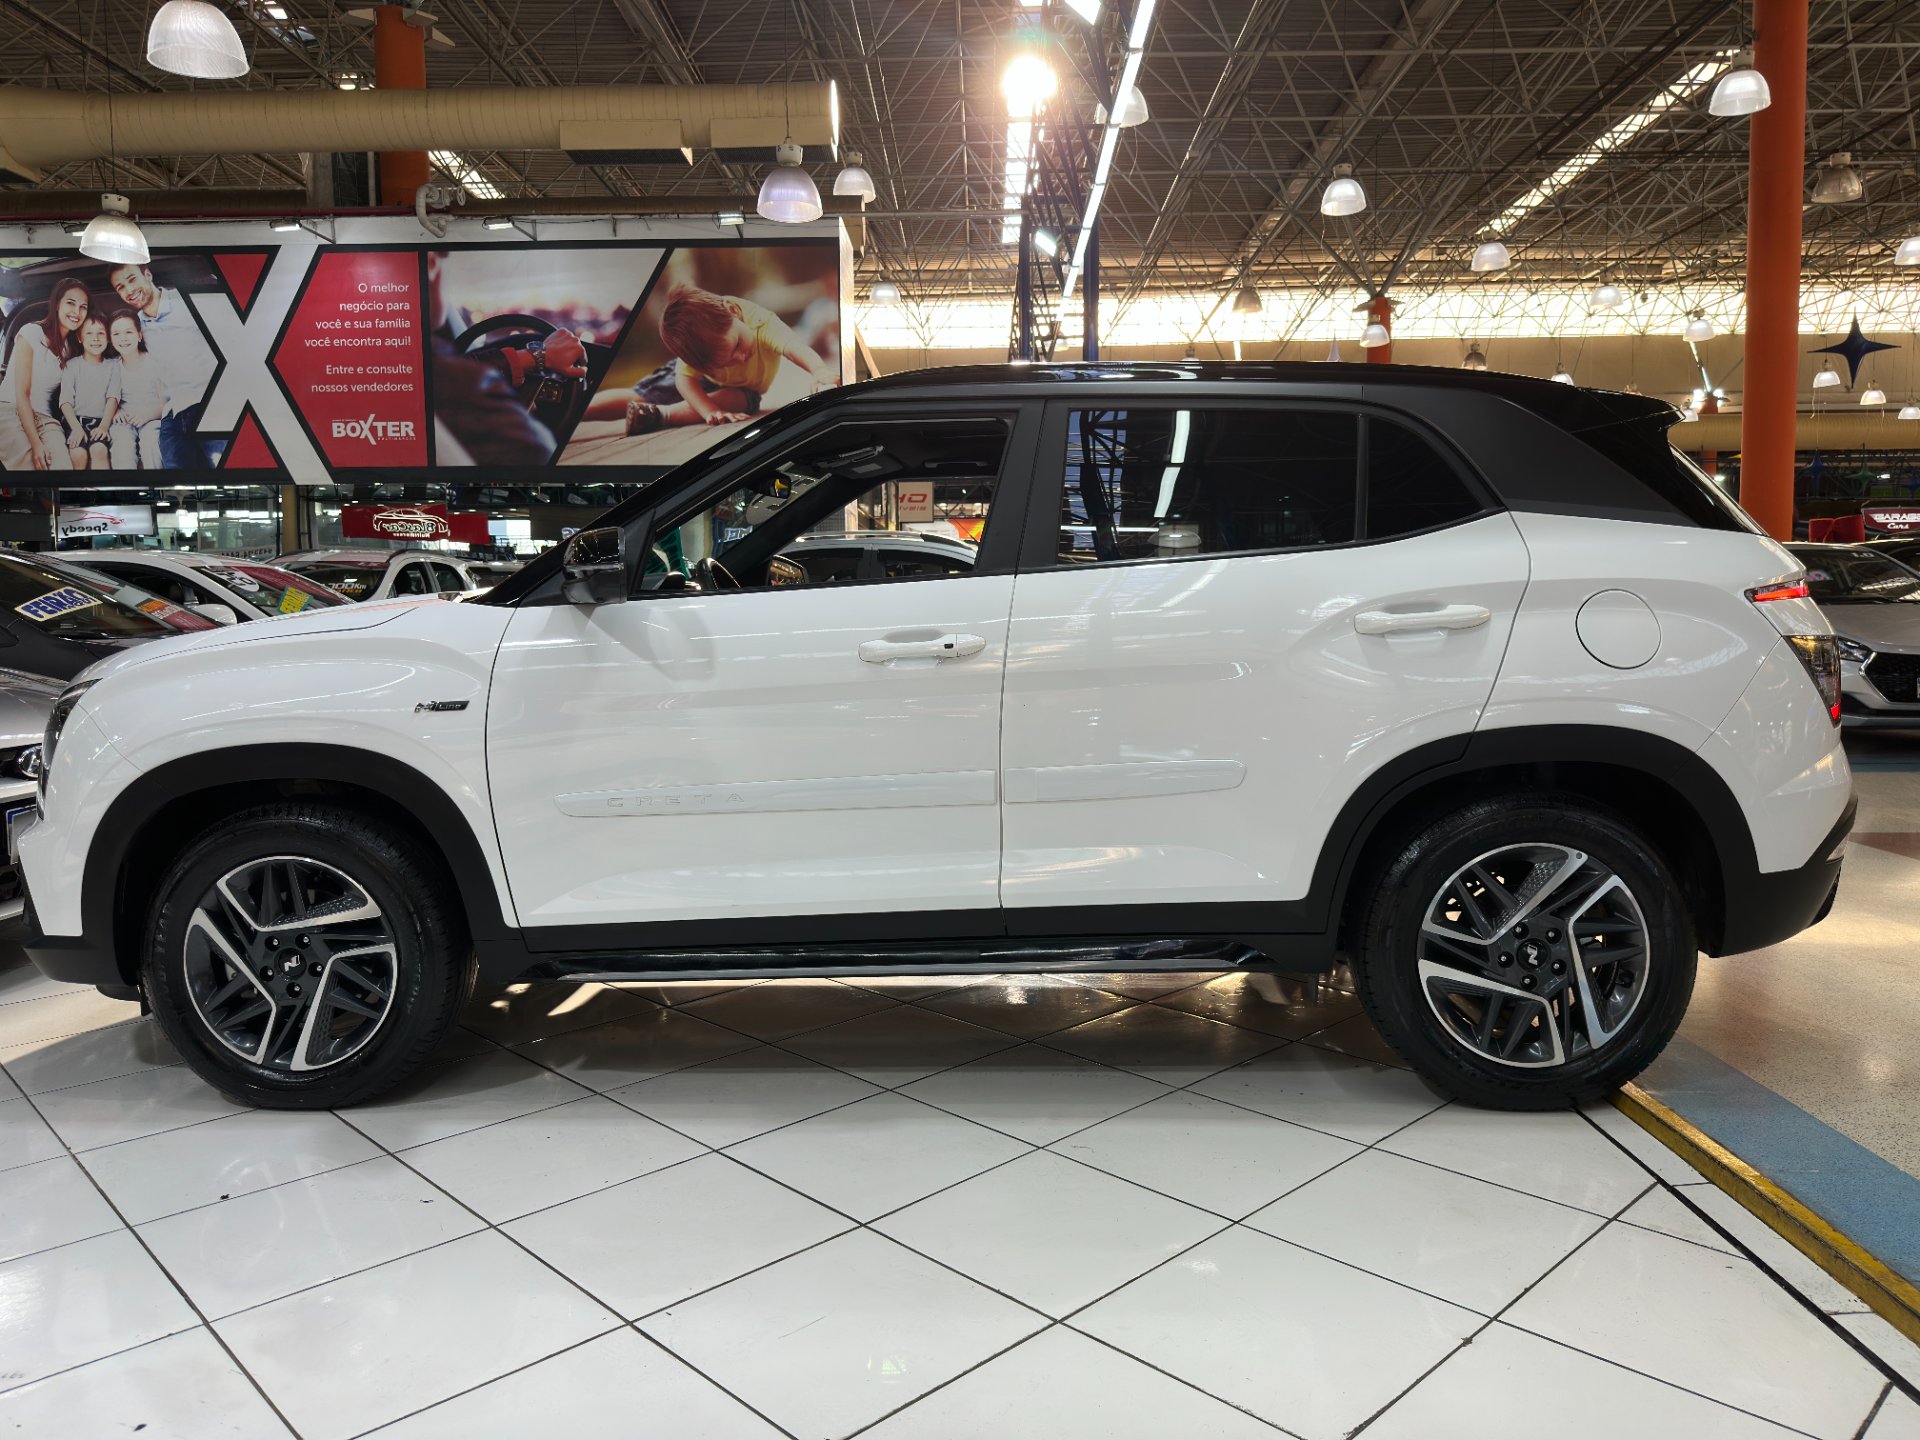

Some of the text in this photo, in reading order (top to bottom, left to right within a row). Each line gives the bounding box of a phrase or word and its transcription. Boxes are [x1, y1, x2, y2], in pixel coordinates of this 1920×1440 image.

[358, 283, 410, 293] O melhor
[339, 301, 410, 313] negócio para
[315, 318, 411, 329] você e sua família
[304, 336, 412, 348] você encontra aqui!
[325, 365, 354, 375] Entre
[366, 364, 413, 374] consulte
[311, 382, 414, 392] nossos vendedores
[331, 413, 416, 446] BOXTER
